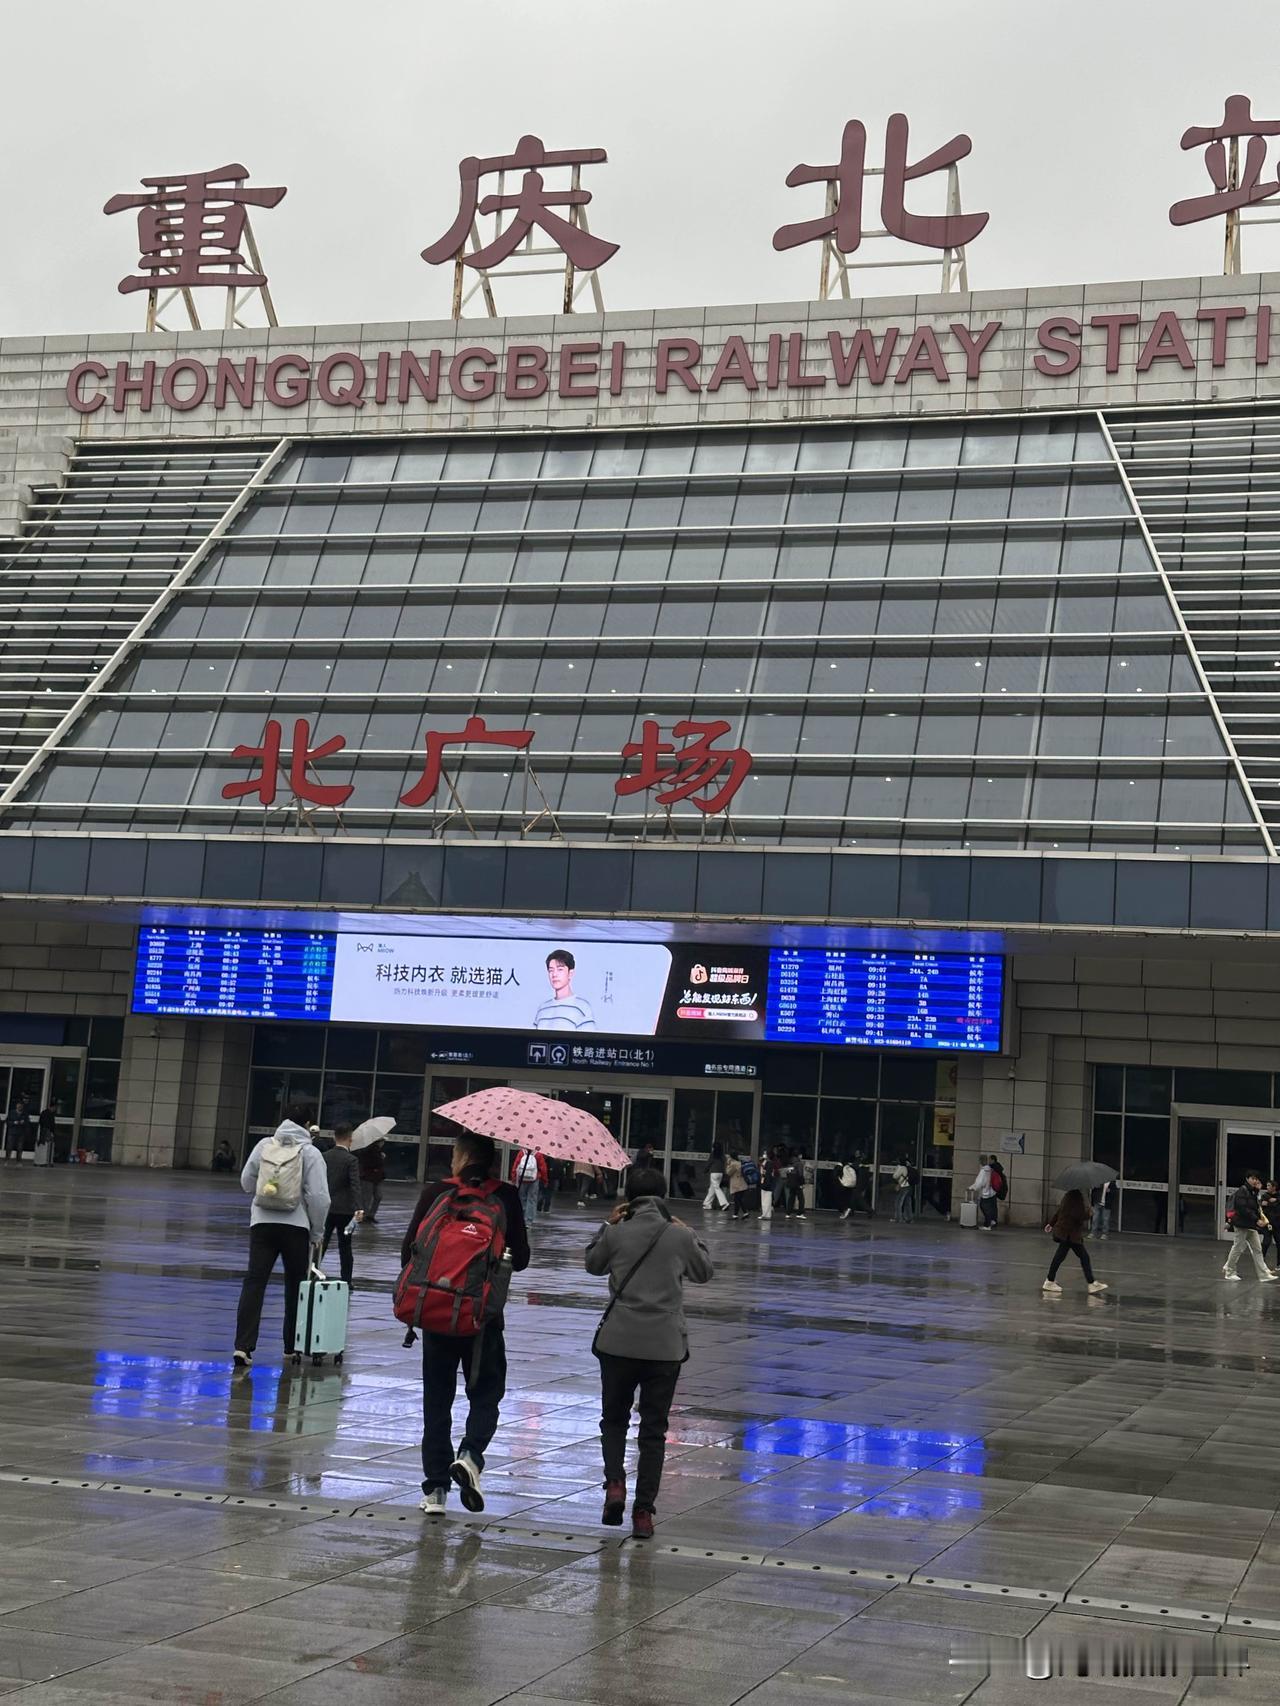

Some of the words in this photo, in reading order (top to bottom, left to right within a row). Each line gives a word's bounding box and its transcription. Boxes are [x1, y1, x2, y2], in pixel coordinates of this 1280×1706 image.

[66, 340, 625, 413] CHONGQINGBEI
[655, 321, 1002, 393] RAILWAY
[221, 716, 754, 814] 北广场
[375, 964, 445, 984] 科技内衣
[450, 966, 521, 986] 就选猫人
[573, 1046, 655, 1061] 铁路进站口(北1)
[590, 1059, 612, 1067] Railway
